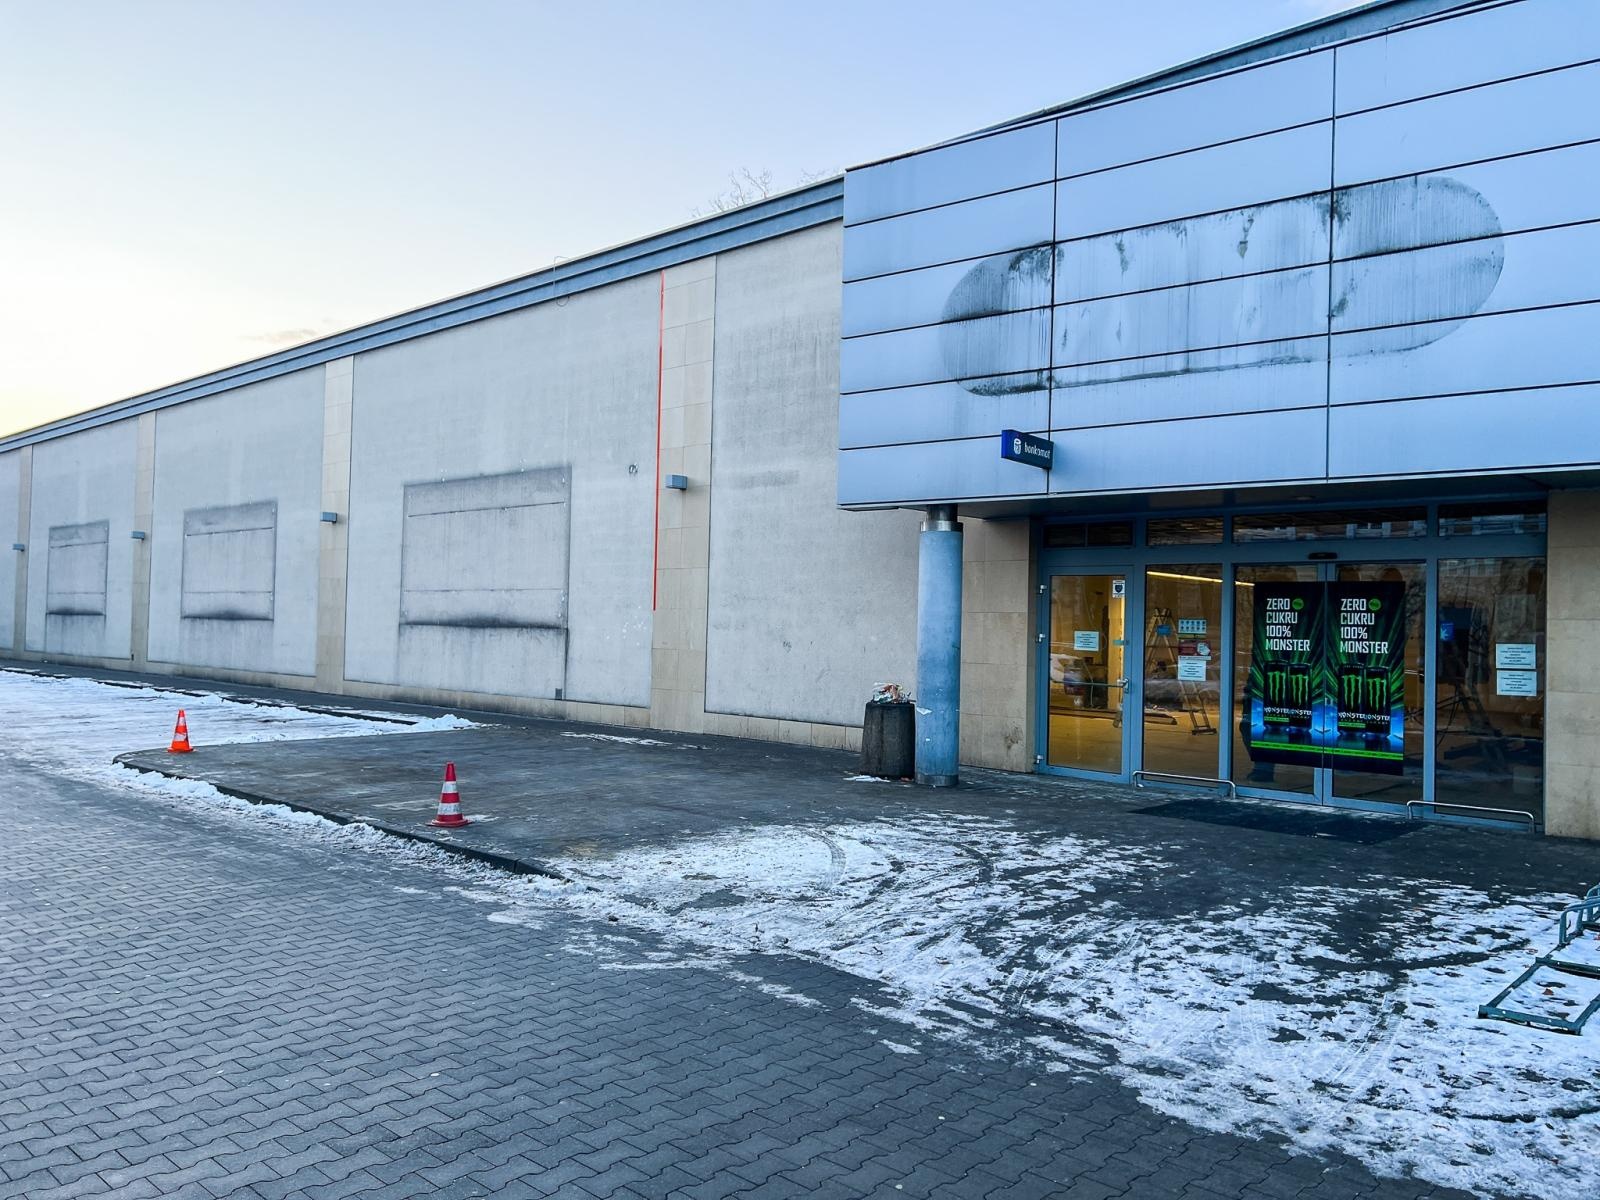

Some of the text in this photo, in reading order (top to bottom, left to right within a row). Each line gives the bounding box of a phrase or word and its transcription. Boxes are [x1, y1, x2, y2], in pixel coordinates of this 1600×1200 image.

[1266, 598, 1290, 610] ZERO
[1340, 599, 1367, 611] ZERO
[1266, 612, 1298, 624] CUKRU
[1340, 613, 1375, 625] CUKRU
[1266, 625, 1292, 637] 100%
[1340, 627, 1368, 639] 100%
[1265, 639, 1310, 651] MONSTER
[1340, 641, 1388, 654] MONSTER
